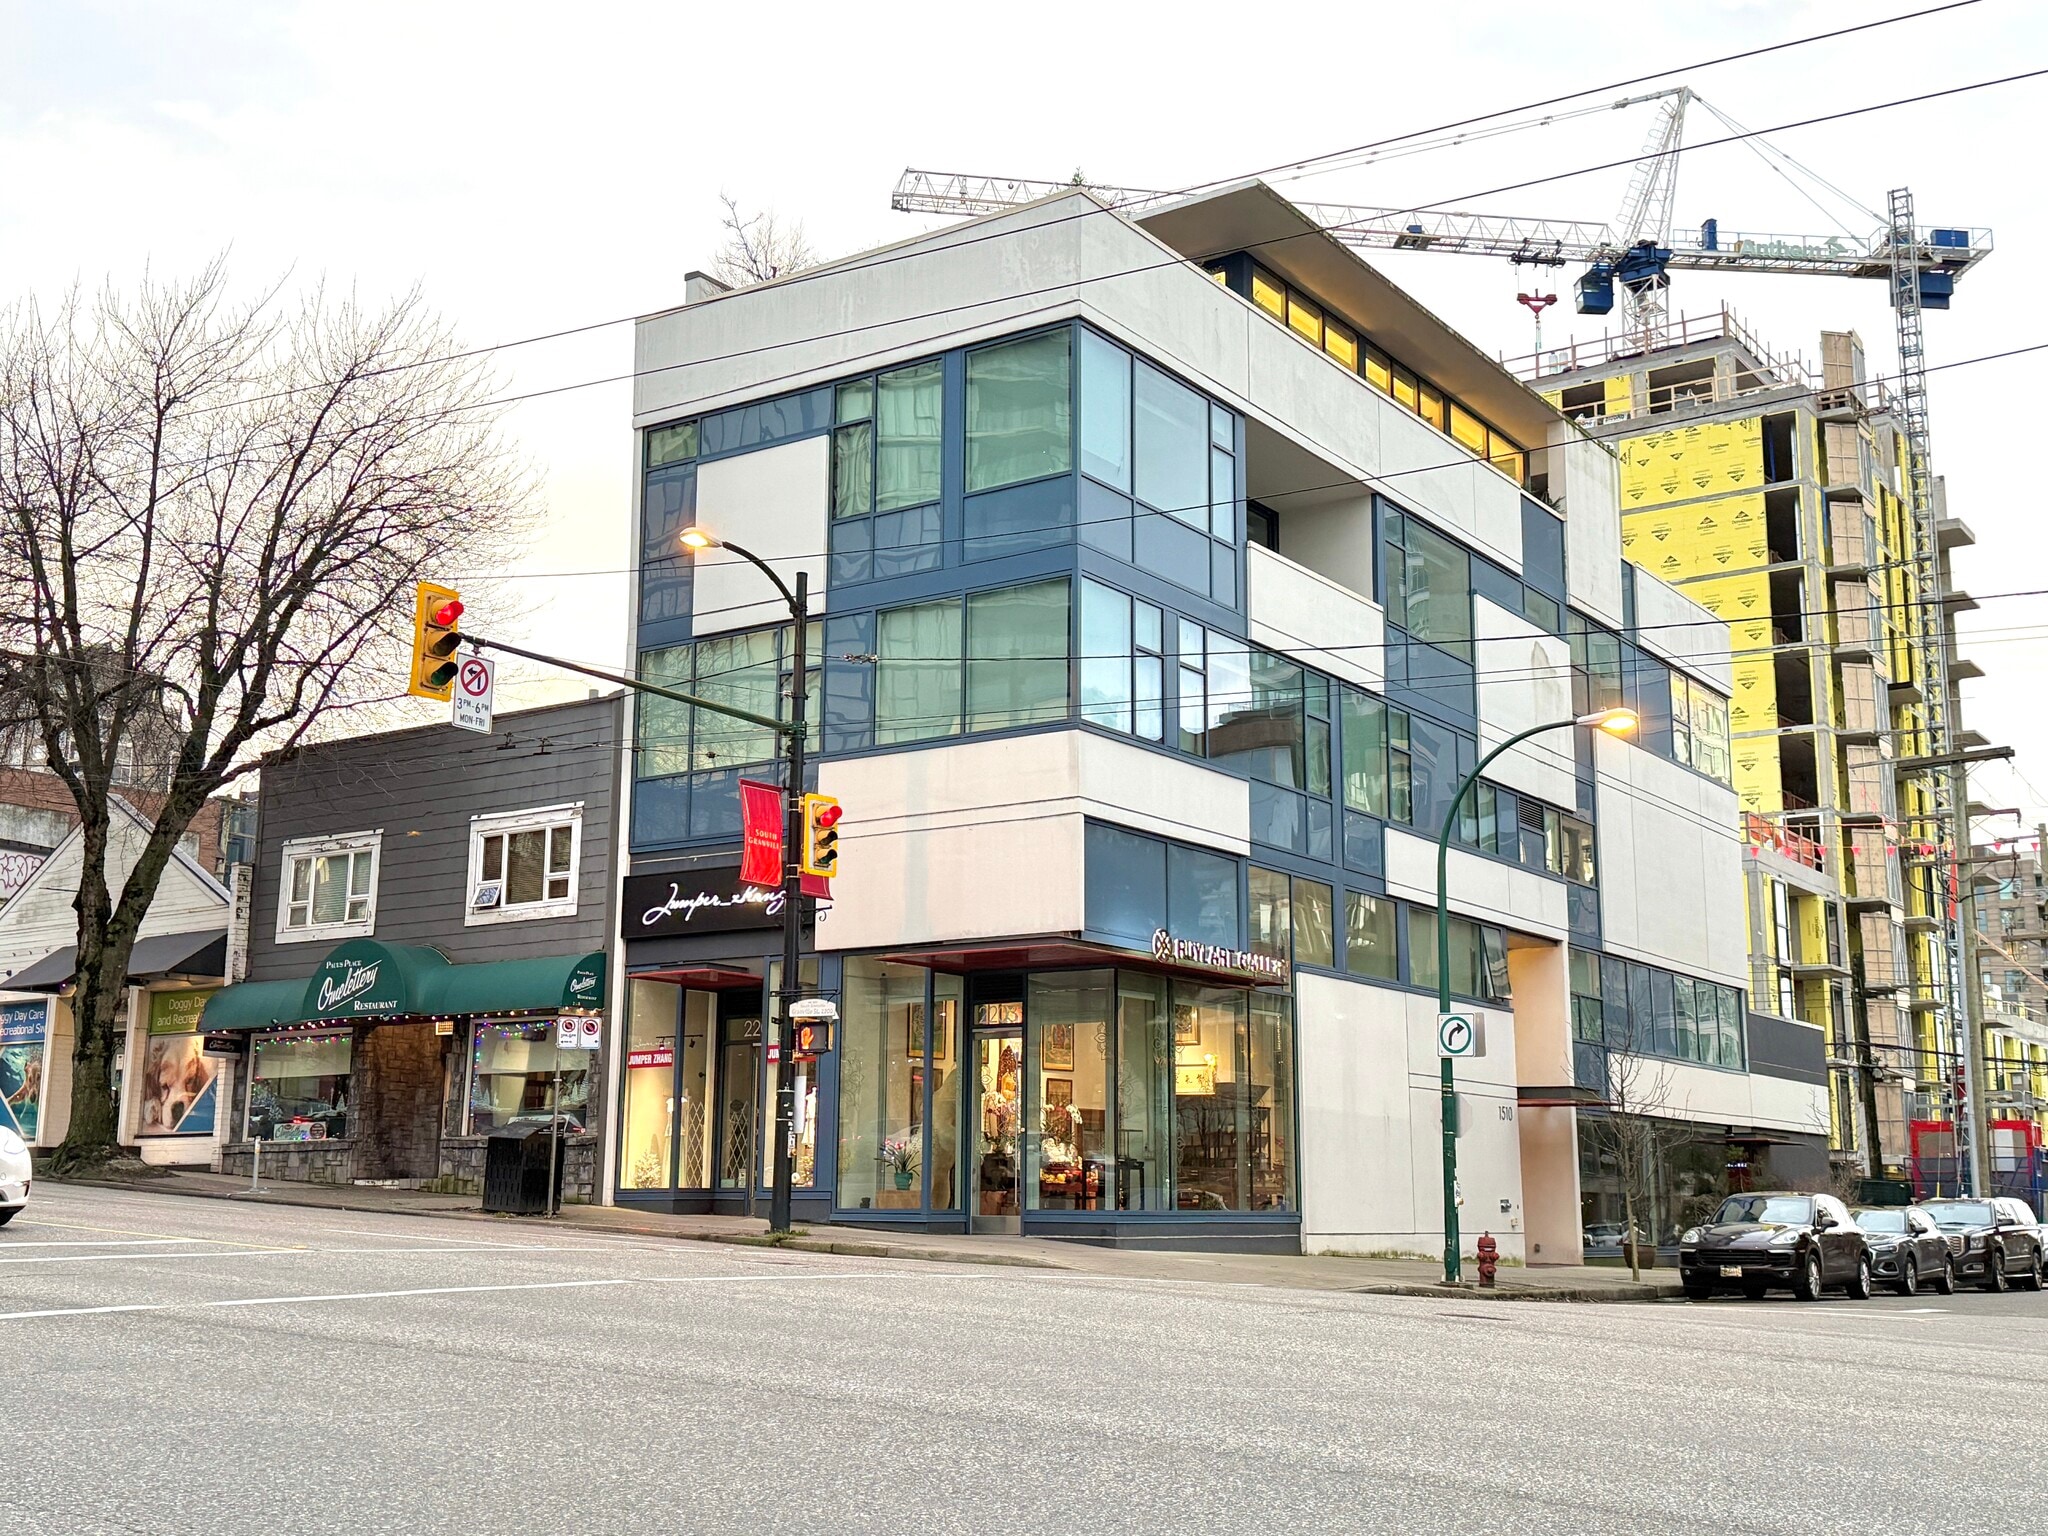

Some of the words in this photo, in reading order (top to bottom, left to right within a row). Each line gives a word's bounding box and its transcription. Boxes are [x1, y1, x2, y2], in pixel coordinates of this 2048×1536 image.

[1740, 239, 1825, 260] Anthem
[460, 713, 486, 727] MON-FRI
[755, 828, 778, 841] SOUTH
[168, 998, 193, 1012] Doggy
[354, 1000, 397, 1011] RESTAURANT
[14, 1010, 28, 1023] Day
[29, 1009, 45, 1020] Care
[157, 1013, 172, 1027] and
[744, 1020, 763, 1037] 22
[628, 1053, 653, 1066] JUMPER
[653, 1052, 673, 1065] ZHANG
[1498, 1105, 1513, 1122] 1510
